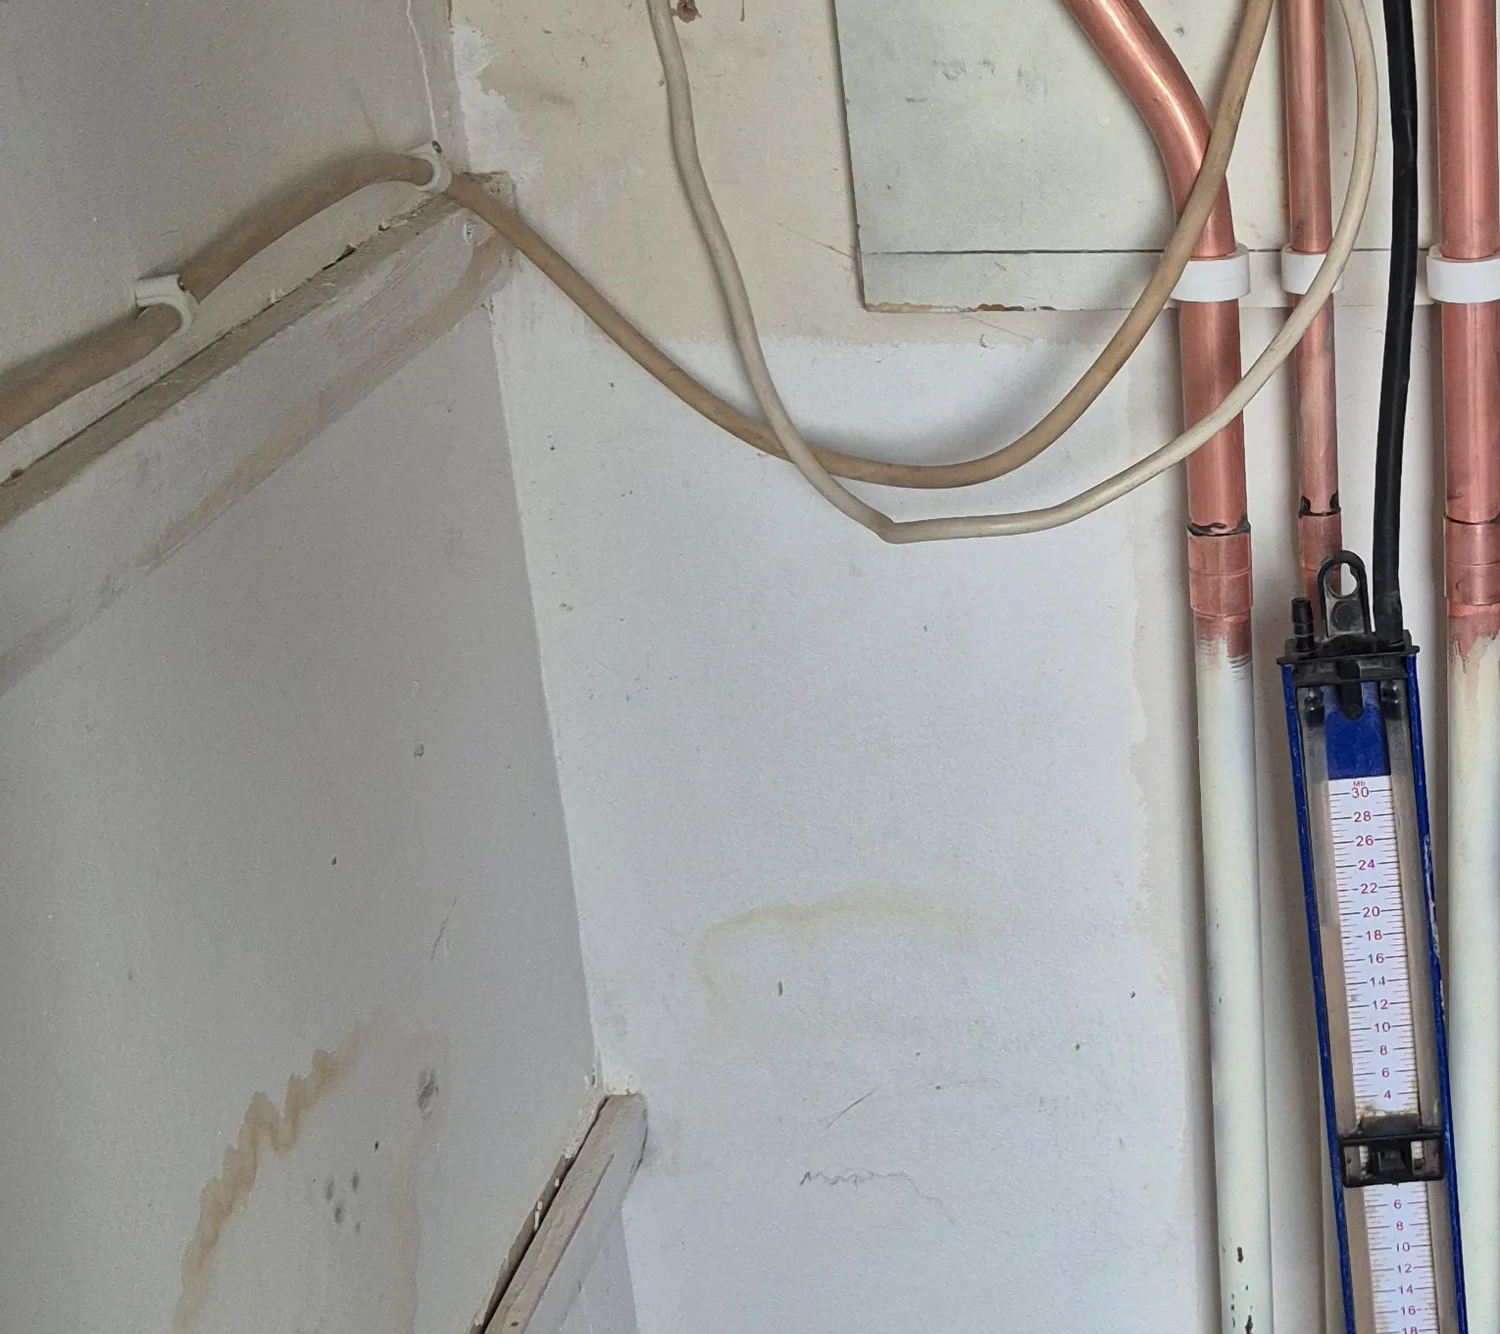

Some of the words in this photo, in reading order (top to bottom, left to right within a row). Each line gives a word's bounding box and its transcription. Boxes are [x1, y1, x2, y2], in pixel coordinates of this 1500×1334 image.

[1352, 786, 1370, 799] 30
[1354, 811, 1372, 823] 28
[1356, 835, 1374, 847] 26
[1358, 859, 1376, 871] 24
[1360, 883, 1378, 895] 22
[1362, 906, 1380, 918] 20
[1366, 929, 1382, 941] 18
[1368, 953, 1384, 964] 16
[1370, 976, 1386, 987] 14
[1373, 999, 1388, 1010] 12
[1375, 1022, 1390, 1033] 10
[1380, 1045, 1388, 1056] 8
[1382, 1067, 1390, 1078] 6
[1384, 1090, 1392, 1099] 4
[1394, 1199, 1402, 1209] 6
[1396, 1221, 1404, 1231] 8
[1396, 1242, 1410, 1252] 10
[1397, 1263, 1412, 1273] 12
[1400, 1285, 1414, 1295] 14
[1400, 1305, 1416, 1316] 16
